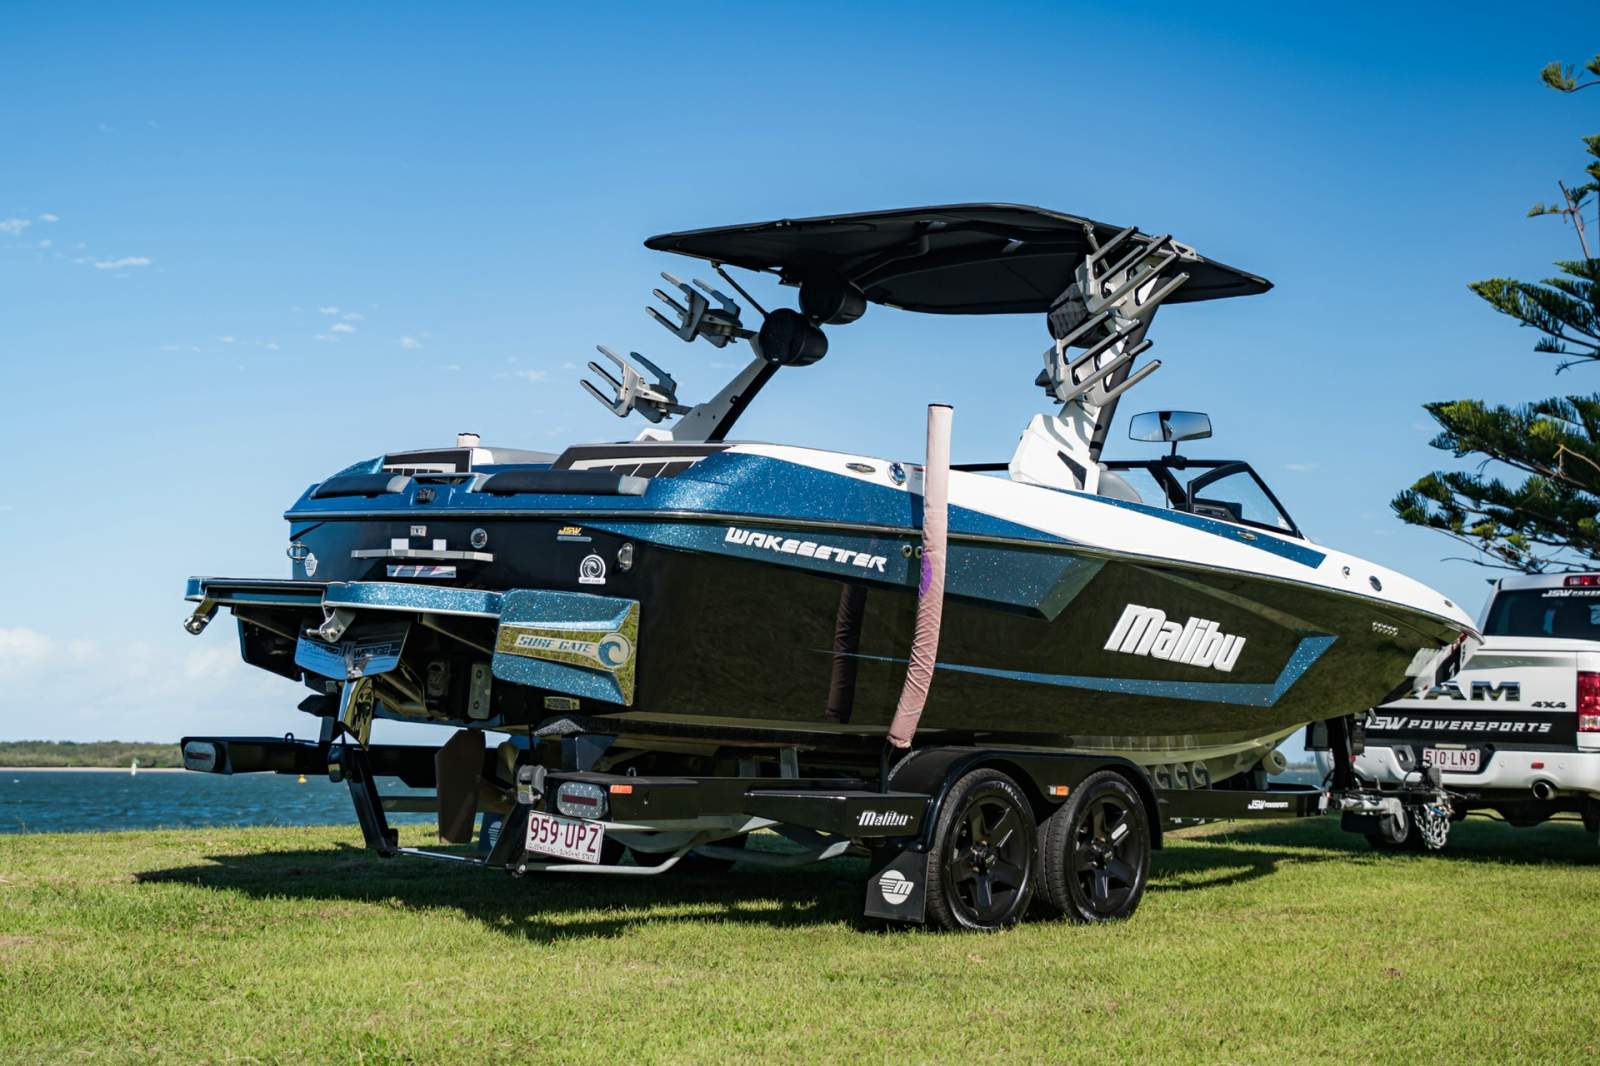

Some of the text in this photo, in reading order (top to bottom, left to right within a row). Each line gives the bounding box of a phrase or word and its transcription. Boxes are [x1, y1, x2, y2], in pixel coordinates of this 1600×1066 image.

[724, 527, 888, 573] WAKESETTER
[1541, 589, 1573, 597] JSW
[518, 635, 593, 653] SURF GATE
[1103, 603, 1247, 673] Malibu
[1402, 680, 1520, 701] AM
[1408, 719, 1552, 733] POWERSPORTS
[858, 811, 909, 826] Malibu
